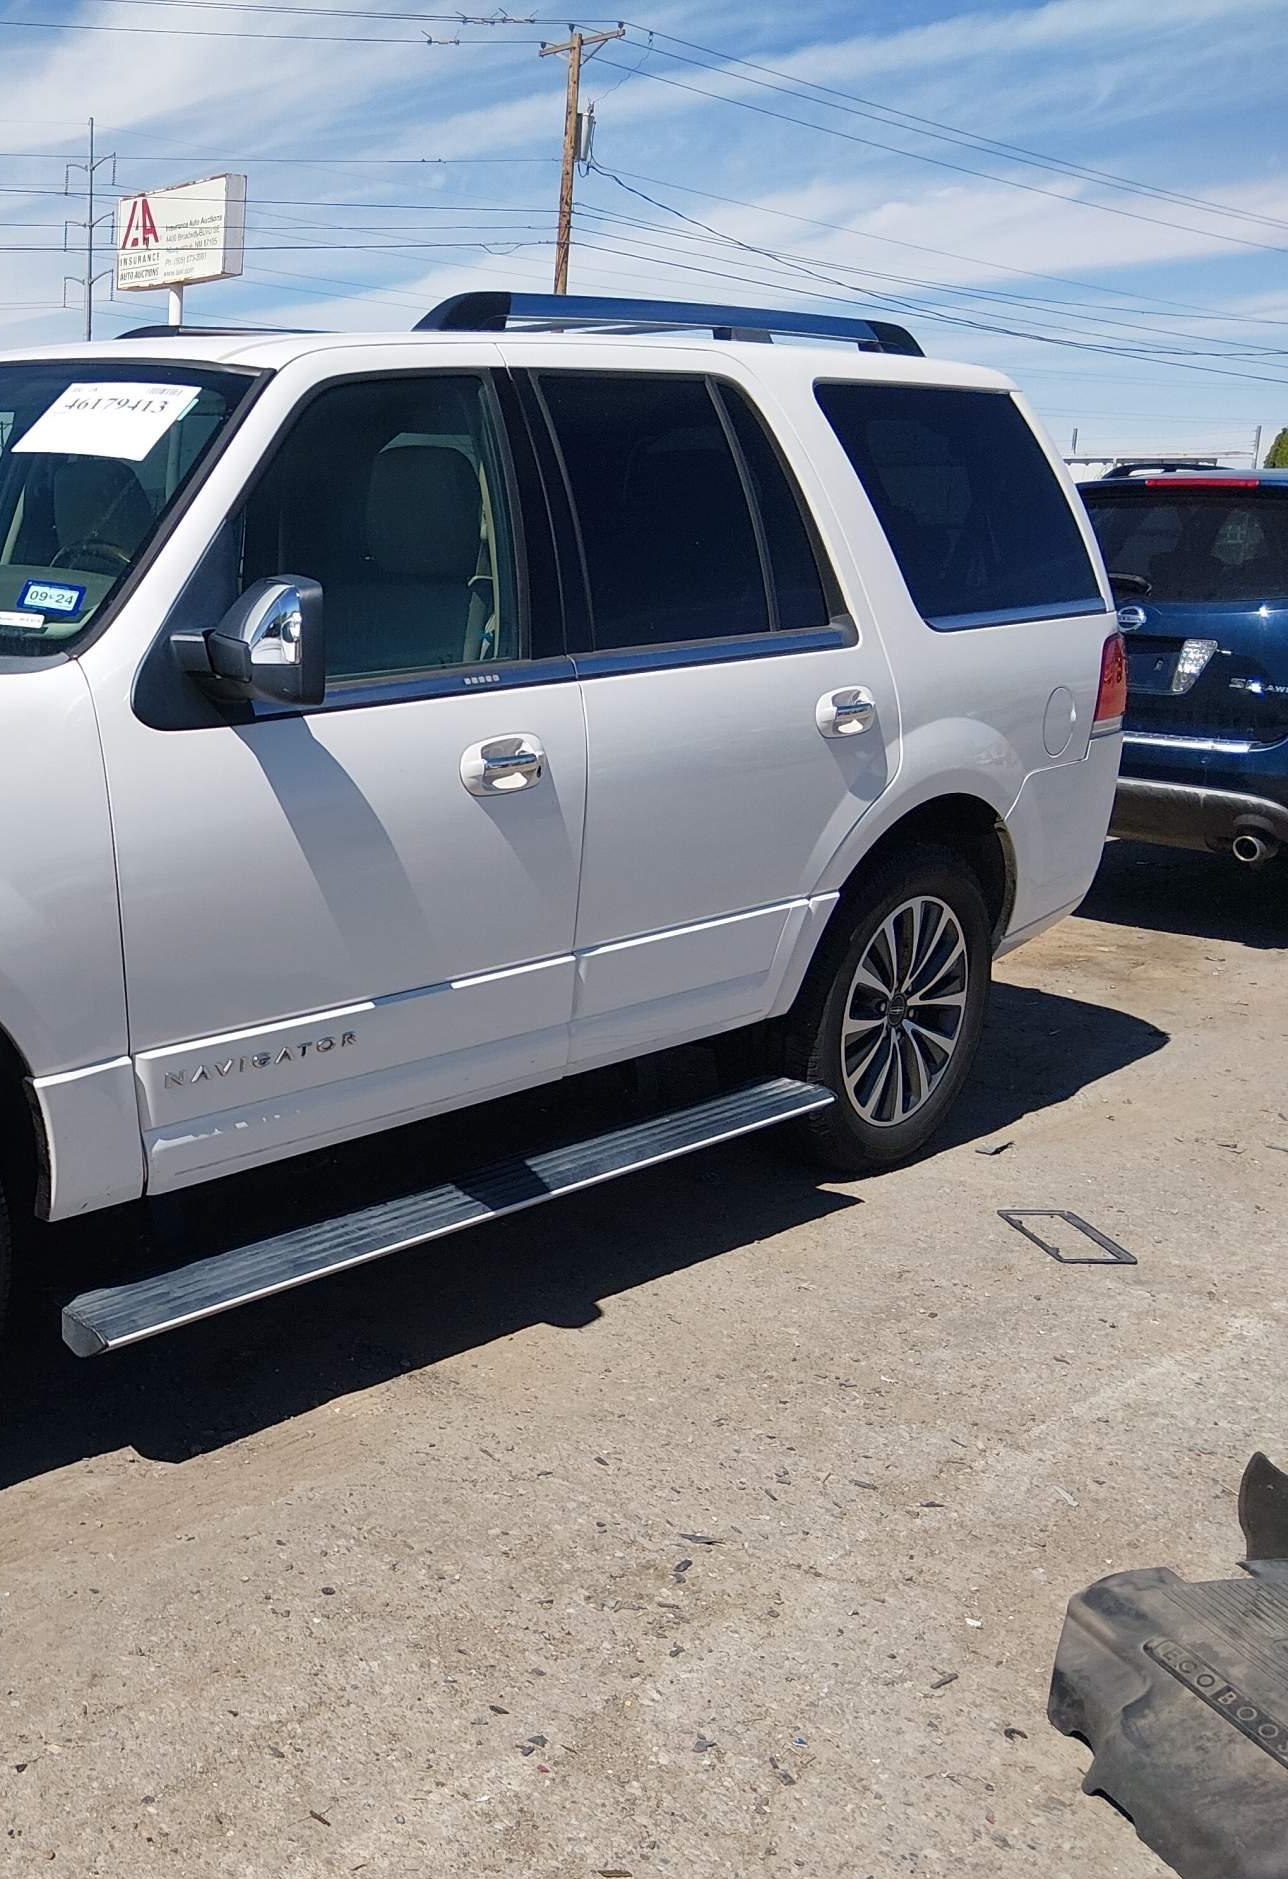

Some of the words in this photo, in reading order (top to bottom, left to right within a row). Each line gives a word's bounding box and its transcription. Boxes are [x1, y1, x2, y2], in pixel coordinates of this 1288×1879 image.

[120, 252, 160, 267] INSURANCE
[120, 271, 133, 281] AUTO
[134, 267, 159, 279] AUCTIONS
[64, 397, 169, 414] 46179413
[29, 590, 48, 602] 09
[55, 593, 74, 605] 24
[163, 1030, 358, 1089] NAVIGATOR
